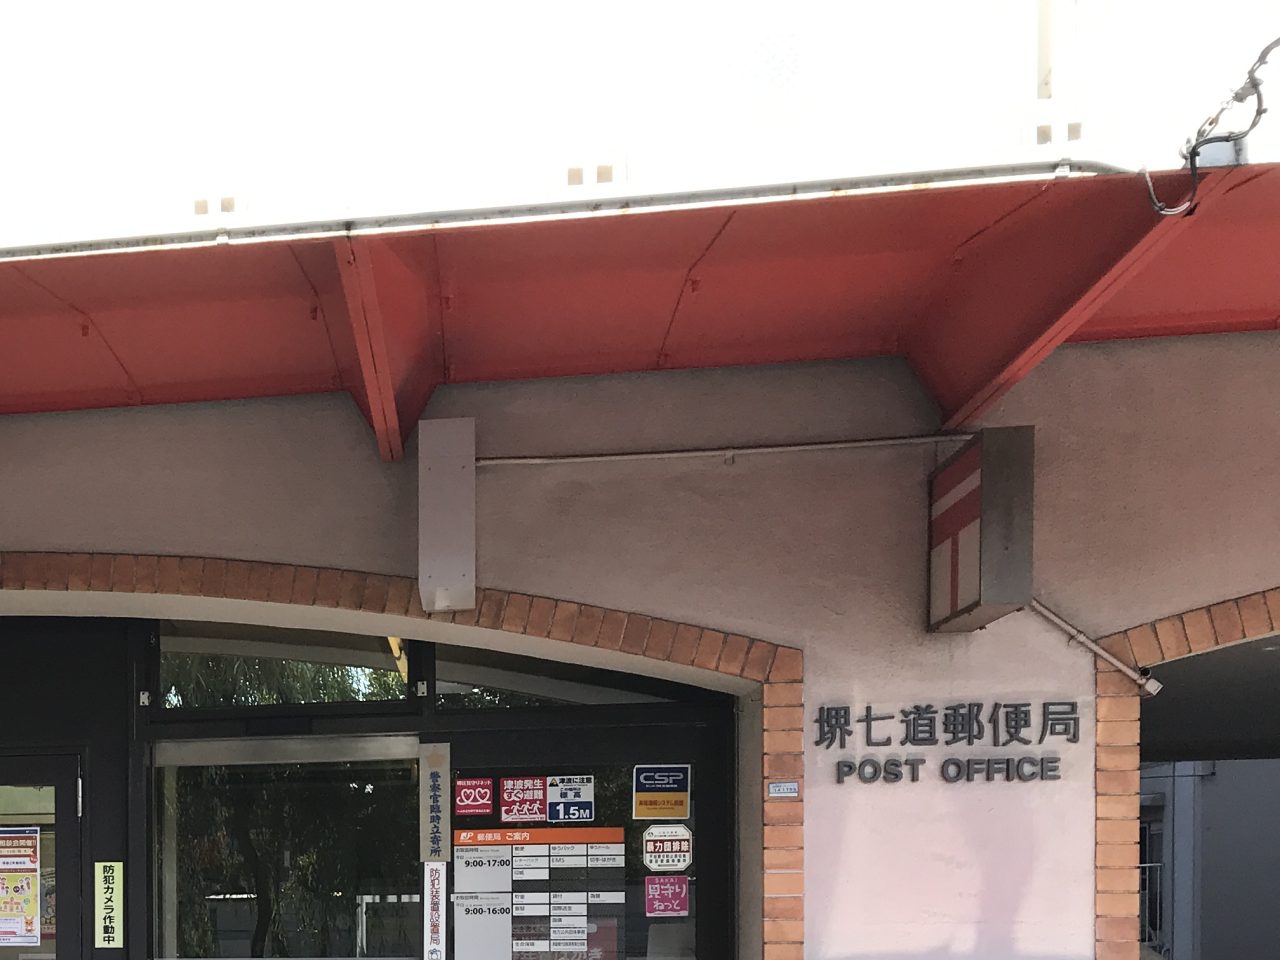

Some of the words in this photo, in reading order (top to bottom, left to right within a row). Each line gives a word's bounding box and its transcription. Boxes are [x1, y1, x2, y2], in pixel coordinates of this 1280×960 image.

[814, 702, 1080, 749] 堺七道郵便局
[836, 759, 926, 784] POST
[941, 756, 1061, 783] OFFICE
[504, 780, 543, 789] 津波発生
[640, 772, 683, 784] CSP
[556, 803, 590, 819] 1.5M
[506, 832, 530, 841] ご案内
[649, 884, 687, 899] 見守り
[103, 865, 115, 944] 防犯カメラ作動中
[465, 907, 511, 915] 9:00-16:00
[653, 900, 680, 910] ねっと
